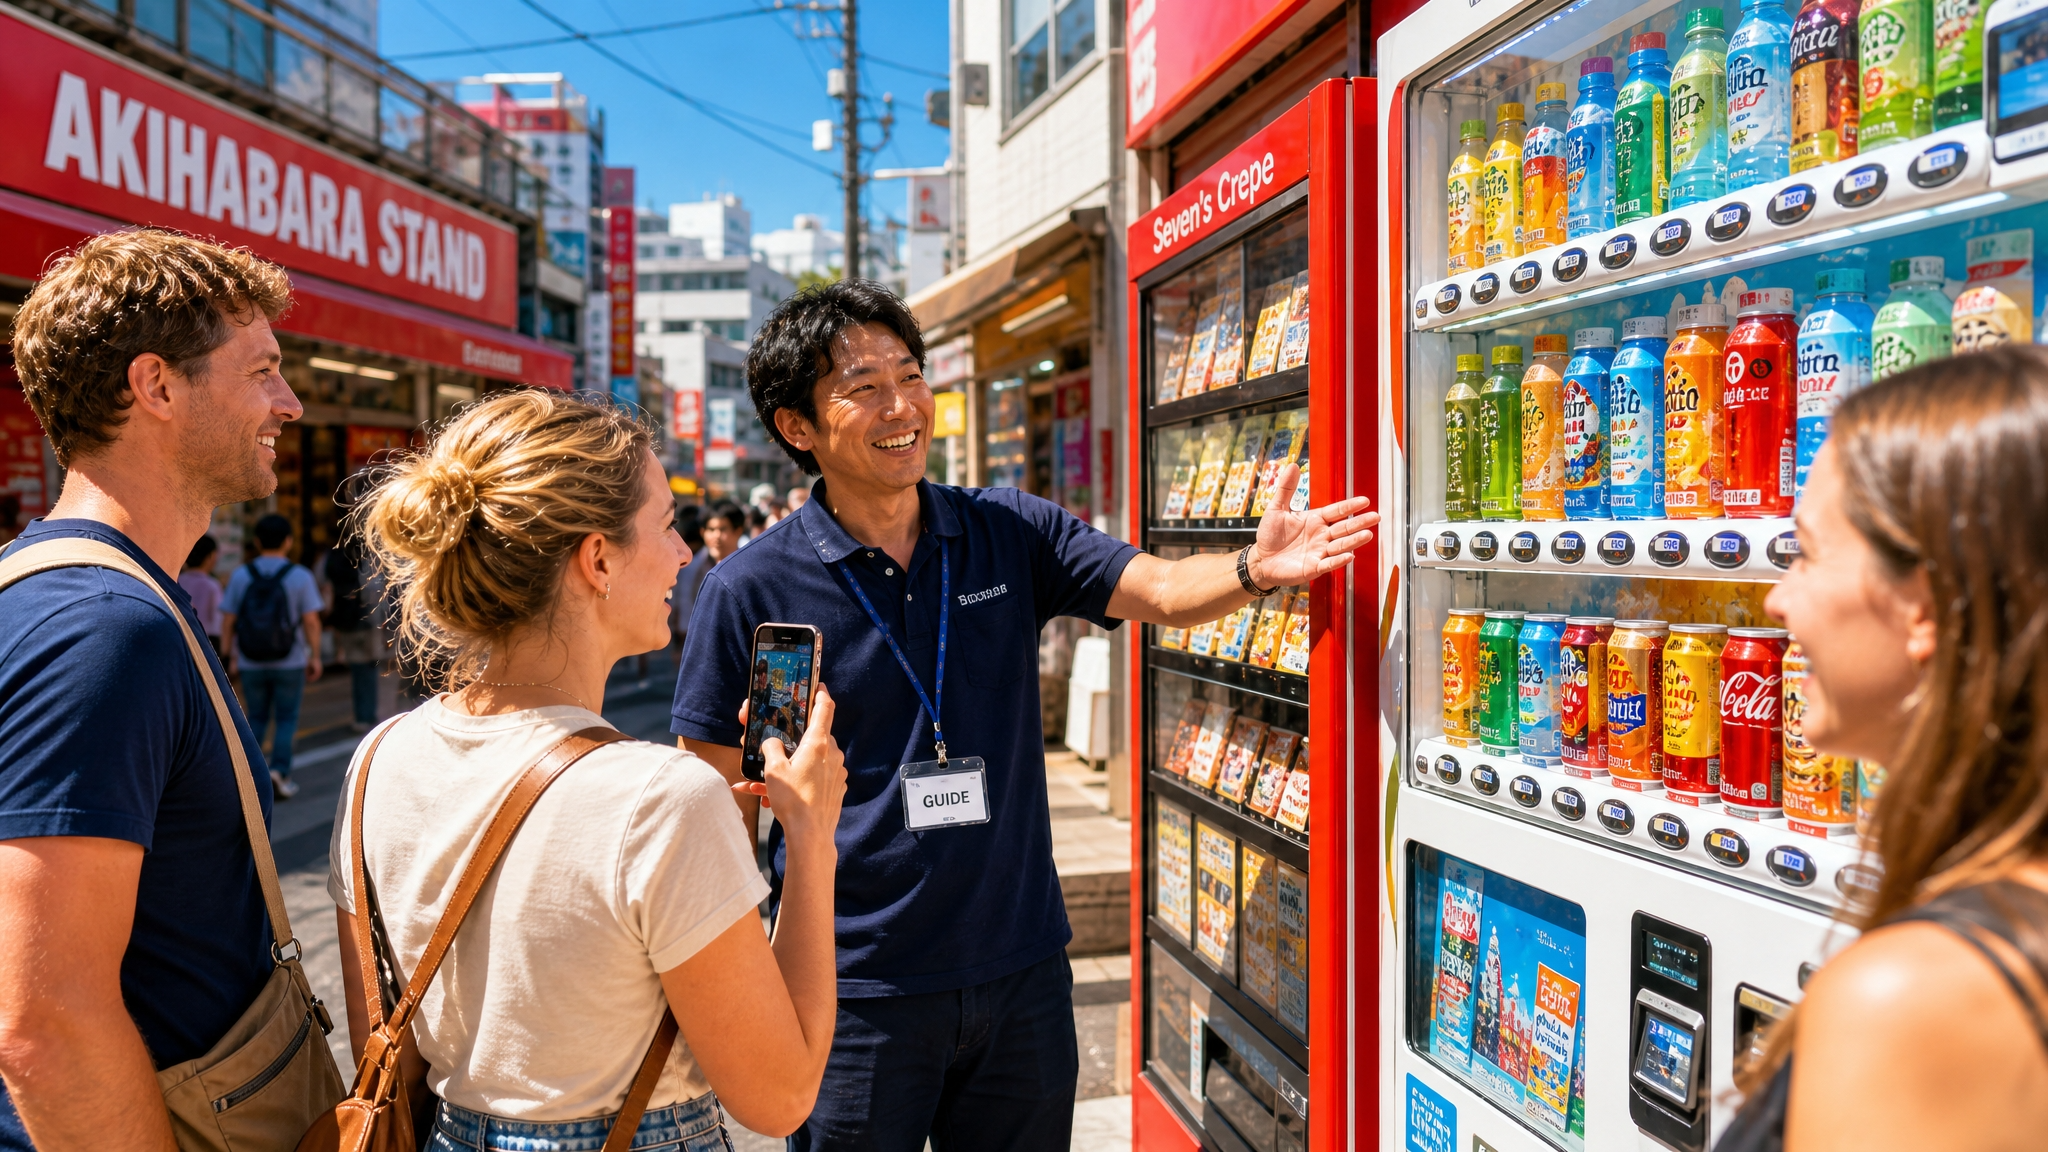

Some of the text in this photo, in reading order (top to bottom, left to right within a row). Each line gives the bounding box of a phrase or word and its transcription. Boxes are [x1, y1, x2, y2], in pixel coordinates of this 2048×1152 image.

[44, 70, 369, 267] AKIHABARA
[378, 199, 487, 301] STAND
[1153, 151, 1274, 254] Seven's Crepe
[923, 790, 970, 808] GUIDE
